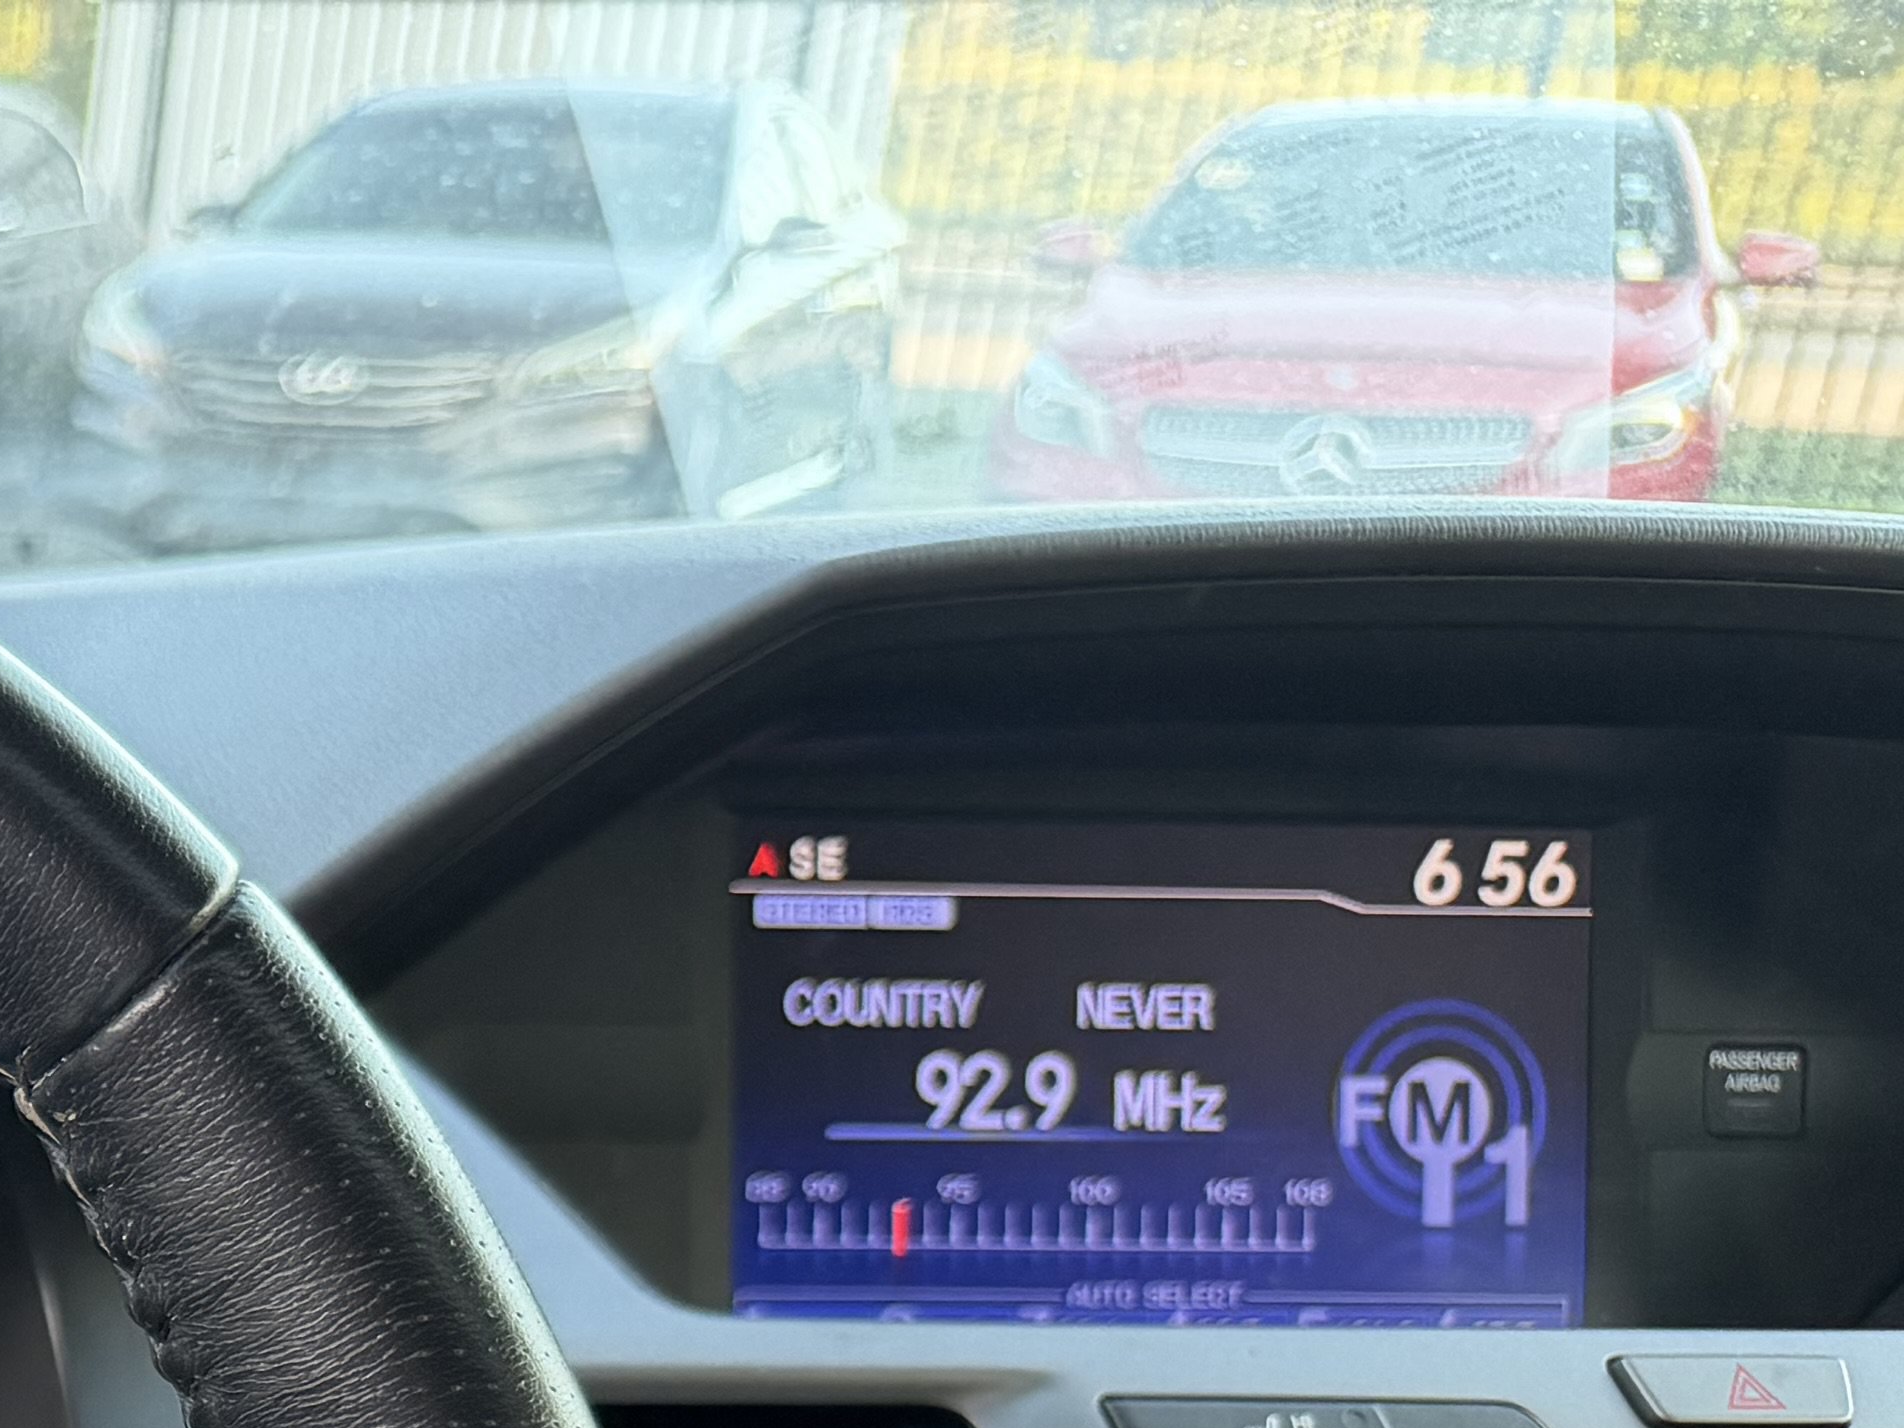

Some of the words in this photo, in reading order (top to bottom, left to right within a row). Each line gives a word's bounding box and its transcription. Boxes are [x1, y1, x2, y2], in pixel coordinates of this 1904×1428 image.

[788, 835, 849, 881] SE
[783, 976, 985, 1029] COUNTRY
[1075, 981, 1217, 1031] NEVER
[1708, 1050, 1800, 1072] PASSENGER
[1724, 1072, 1782, 1093] AIRBAG
[915, 1048, 1077, 1132] 92.9
[1112, 1070, 1227, 1132] MHz
